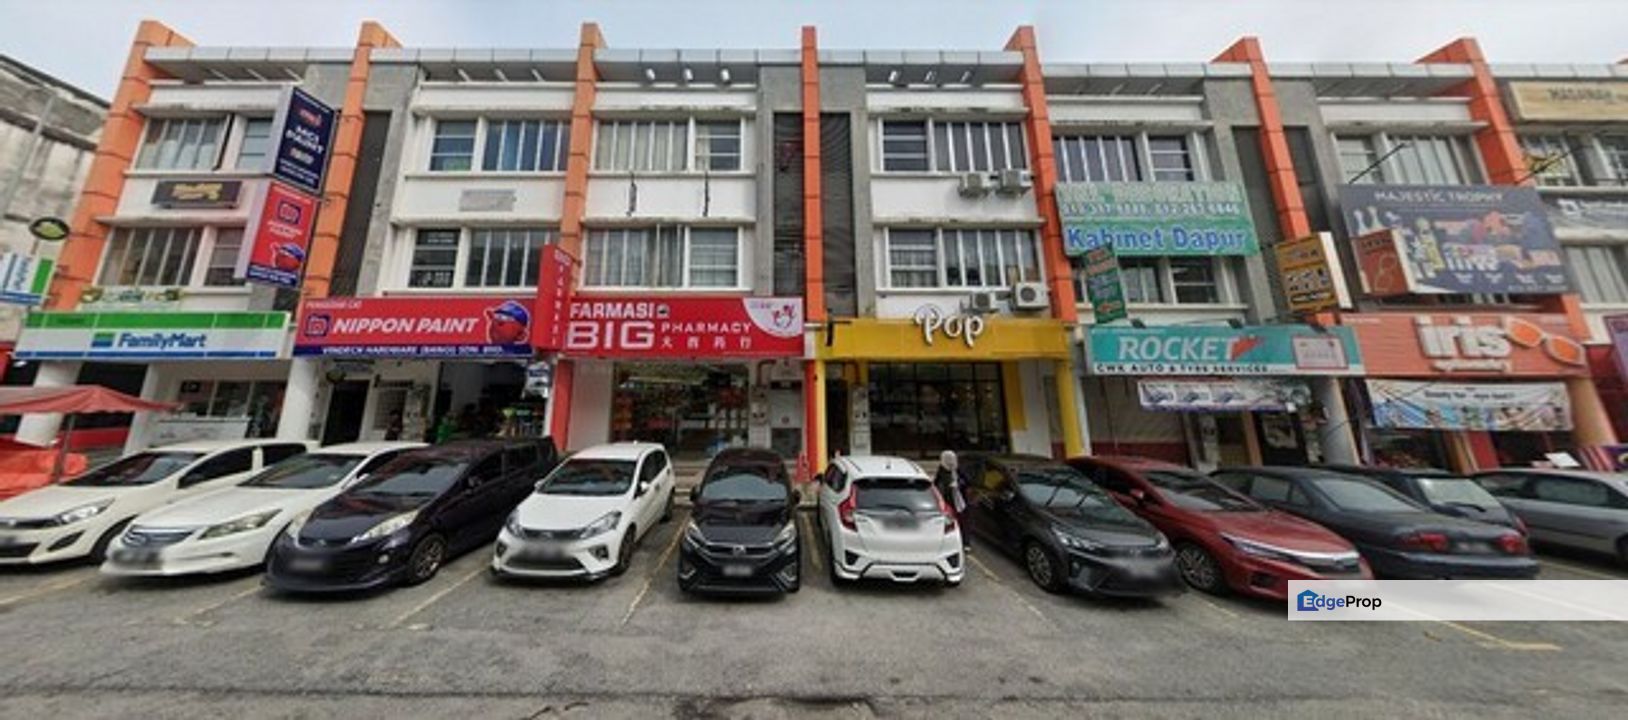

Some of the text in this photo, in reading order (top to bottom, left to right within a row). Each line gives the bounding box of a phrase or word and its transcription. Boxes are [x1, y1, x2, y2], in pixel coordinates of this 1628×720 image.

[1374, 191, 1503, 203] MAJESTIC TROPHY
[1067, 226, 1245, 252] Kabinet Dapur
[570, 302, 654, 319] FARMASI
[332, 318, 479, 334] NIPPON PAINT
[661, 323, 752, 334] PHARMACY
[914, 303, 984, 347] Pop
[118, 332, 208, 350] FamilyMart
[567, 321, 655, 350] BIG
[1413, 315, 1513, 358] iris
[1119, 336, 1240, 360] ROCKET
[1131, 365, 1165, 373] AUTO
